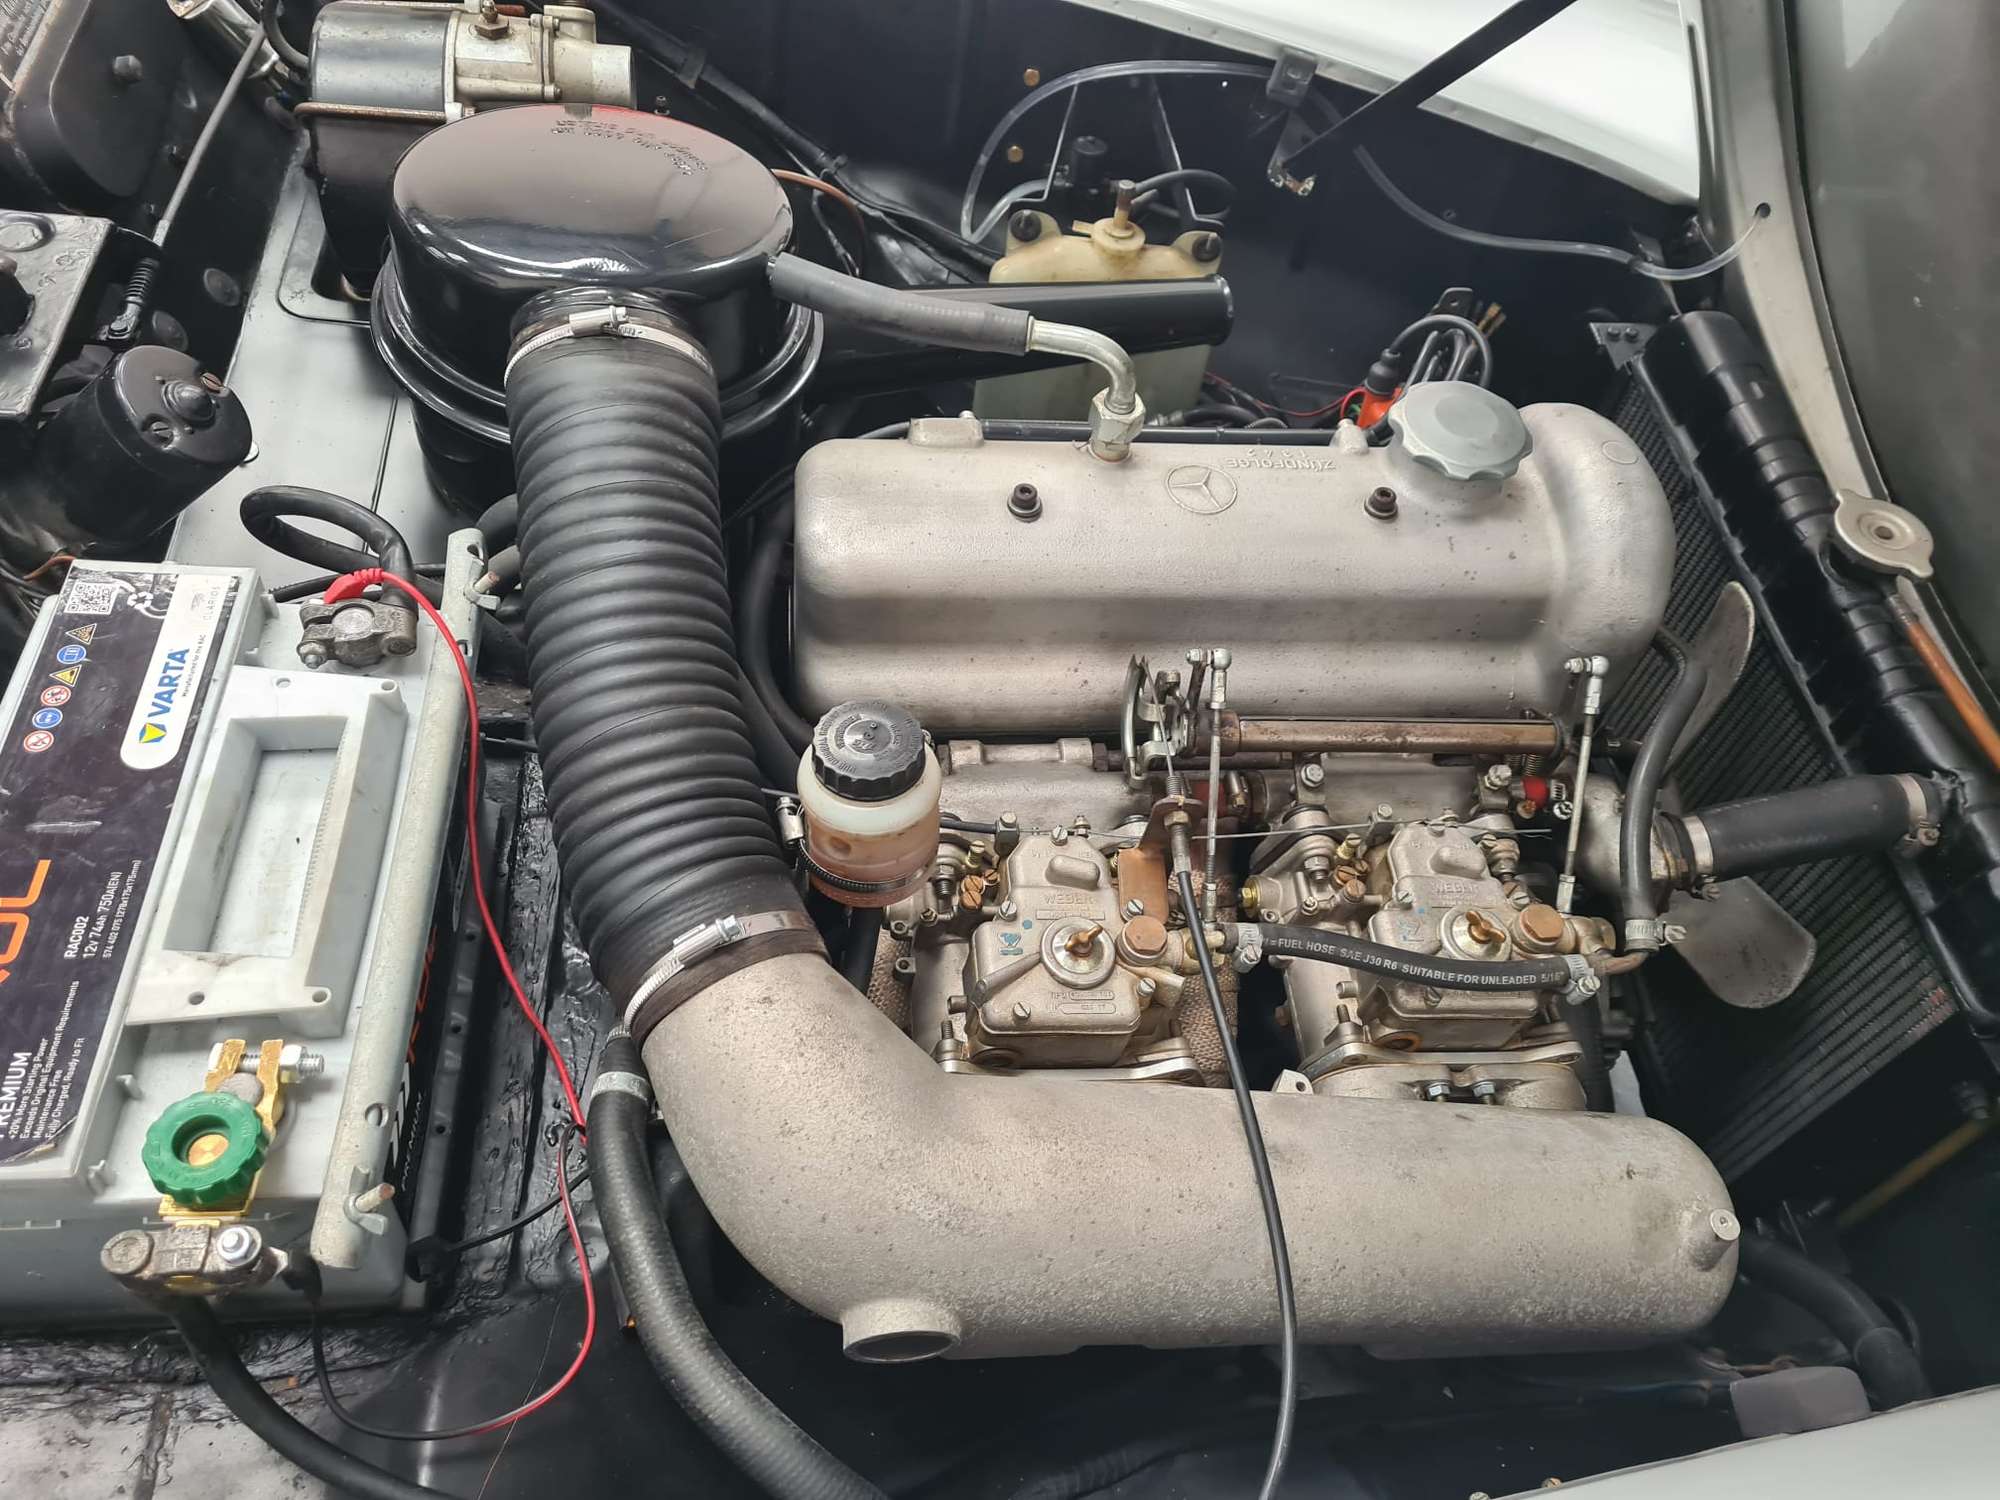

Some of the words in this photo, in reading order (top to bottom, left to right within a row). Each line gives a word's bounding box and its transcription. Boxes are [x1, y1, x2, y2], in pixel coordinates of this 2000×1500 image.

[147, 648, 190, 718] VARTA
[64, 915, 90, 959] RAC002
[88, 914, 108, 939] 74Ah
[1277, 937, 1304, 950] FUEL
[1305, 941, 1336, 955] HOSE
[1340, 947, 1362, 962] SAE
[1363, 952, 1382, 967] J30
[1383, 958, 1399, 971] R6
[1401, 963, 1456, 983] SUITABLE
[1456, 973, 1480, 985] FOR
[1481, 974, 1538, 985] UNLEADED
[20, 1107, 39, 1139] Exceeds
[31, 1073, 49, 1106] Original
[41, 1033, 63, 1074] Equipment
[55, 980, 80, 1031] Requirements
[33, 1038, 49, 1063] Power
[63, 1057, 80, 1082] Ready
[22, 1062, 43, 1095] Starting
[16, 1095, 31, 1116] More
[32, 1088, 57, 1139] Maintenance
[49, 1068, 63, 1087] Free
